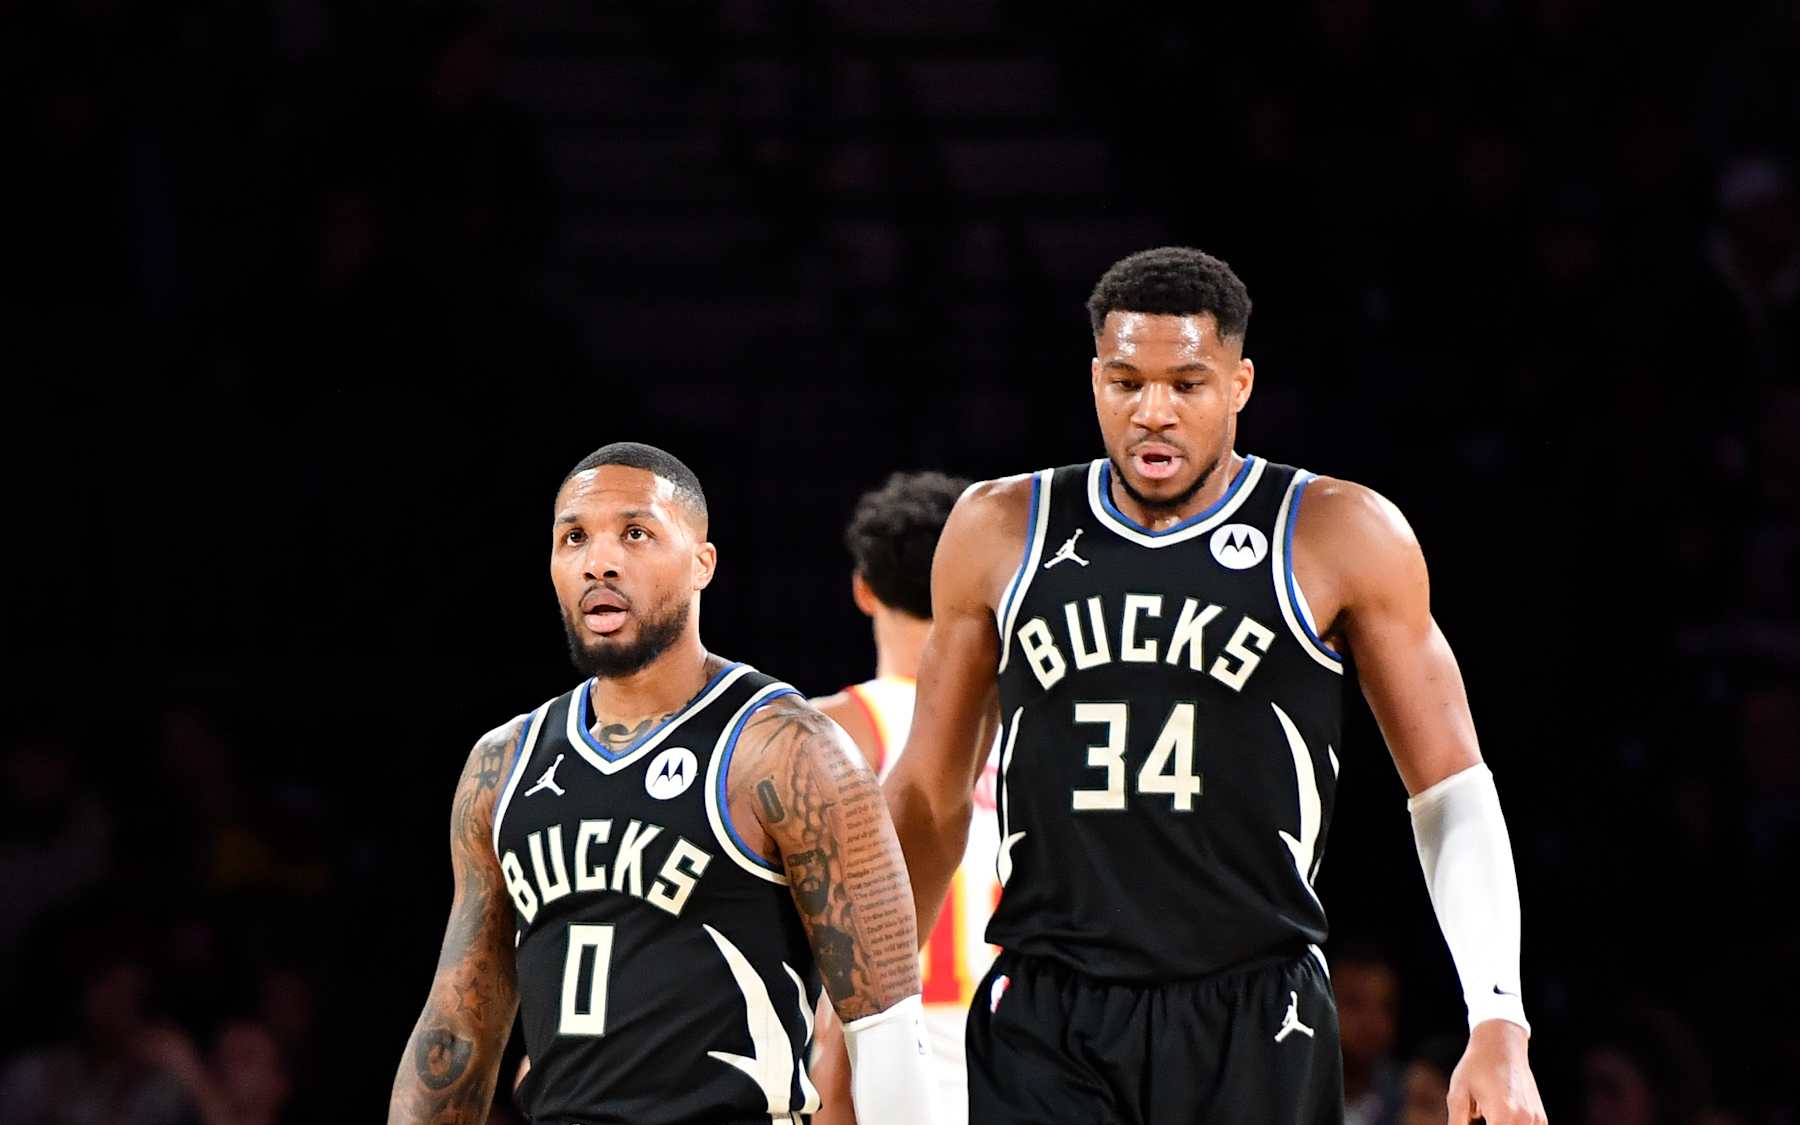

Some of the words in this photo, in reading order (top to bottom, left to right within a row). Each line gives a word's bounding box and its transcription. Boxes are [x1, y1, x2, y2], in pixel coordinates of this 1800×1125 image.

[1017, 592, 1276, 693] BUCKS
[1071, 700, 1203, 813] 34
[500, 818, 713, 925] BUCKS
[557, 922, 615, 1038] 0
